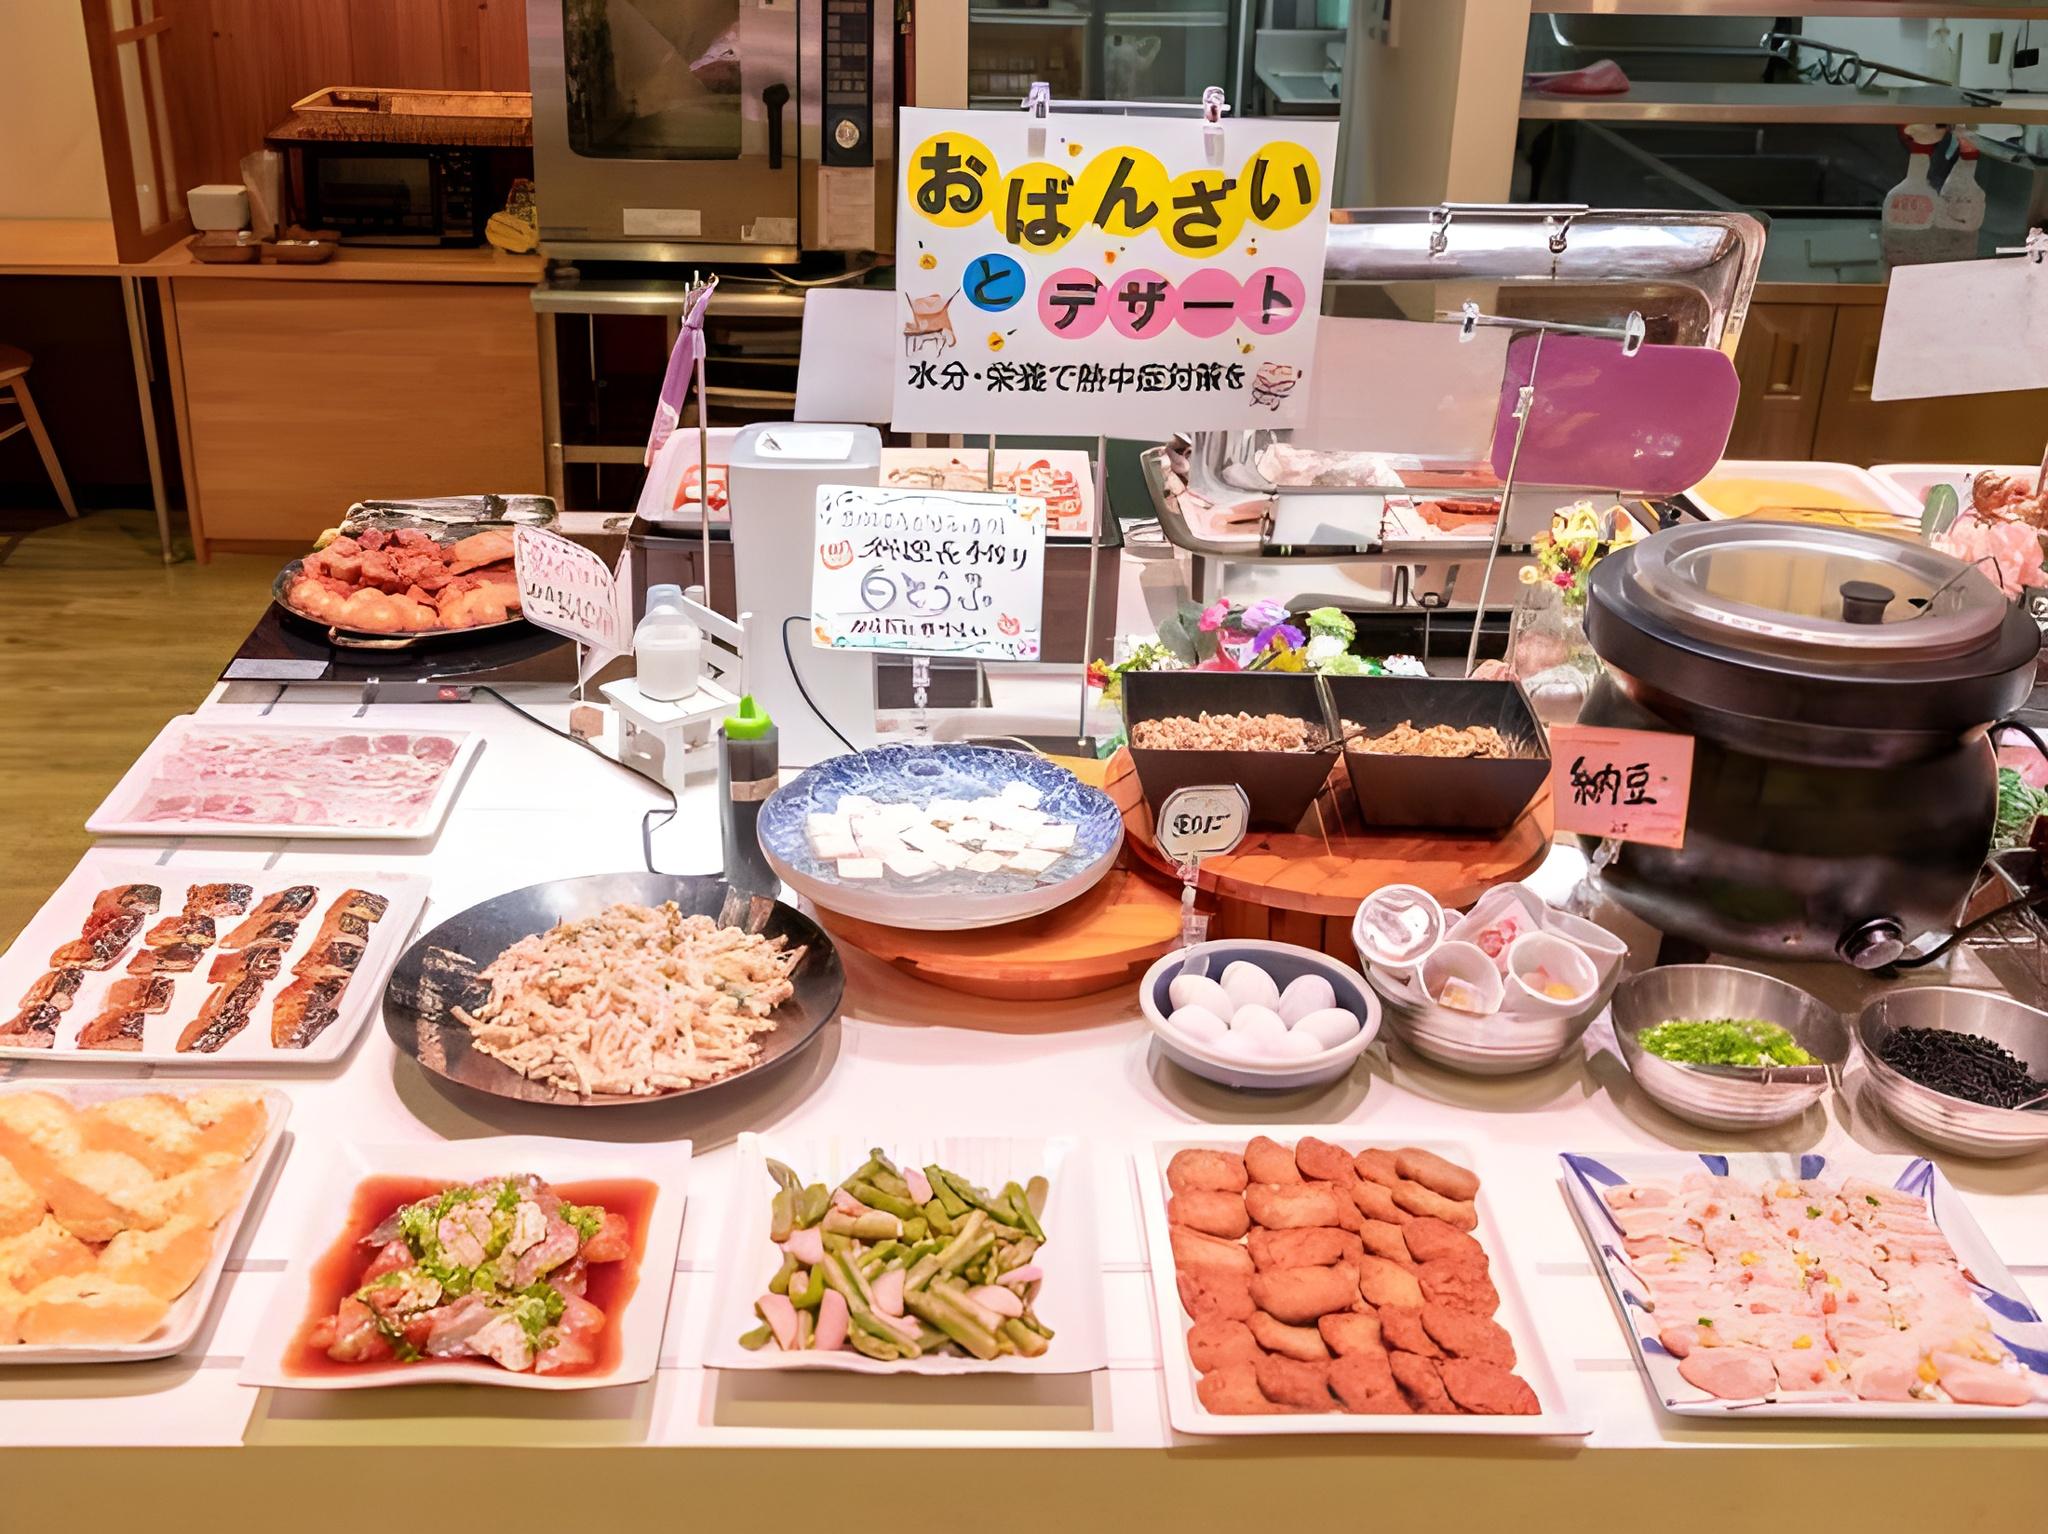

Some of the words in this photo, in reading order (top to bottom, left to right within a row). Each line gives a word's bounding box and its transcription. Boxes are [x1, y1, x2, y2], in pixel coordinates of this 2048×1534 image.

[917, 142, 1312, 248] おばんざい
[1570, 755, 1658, 806] 納豆
